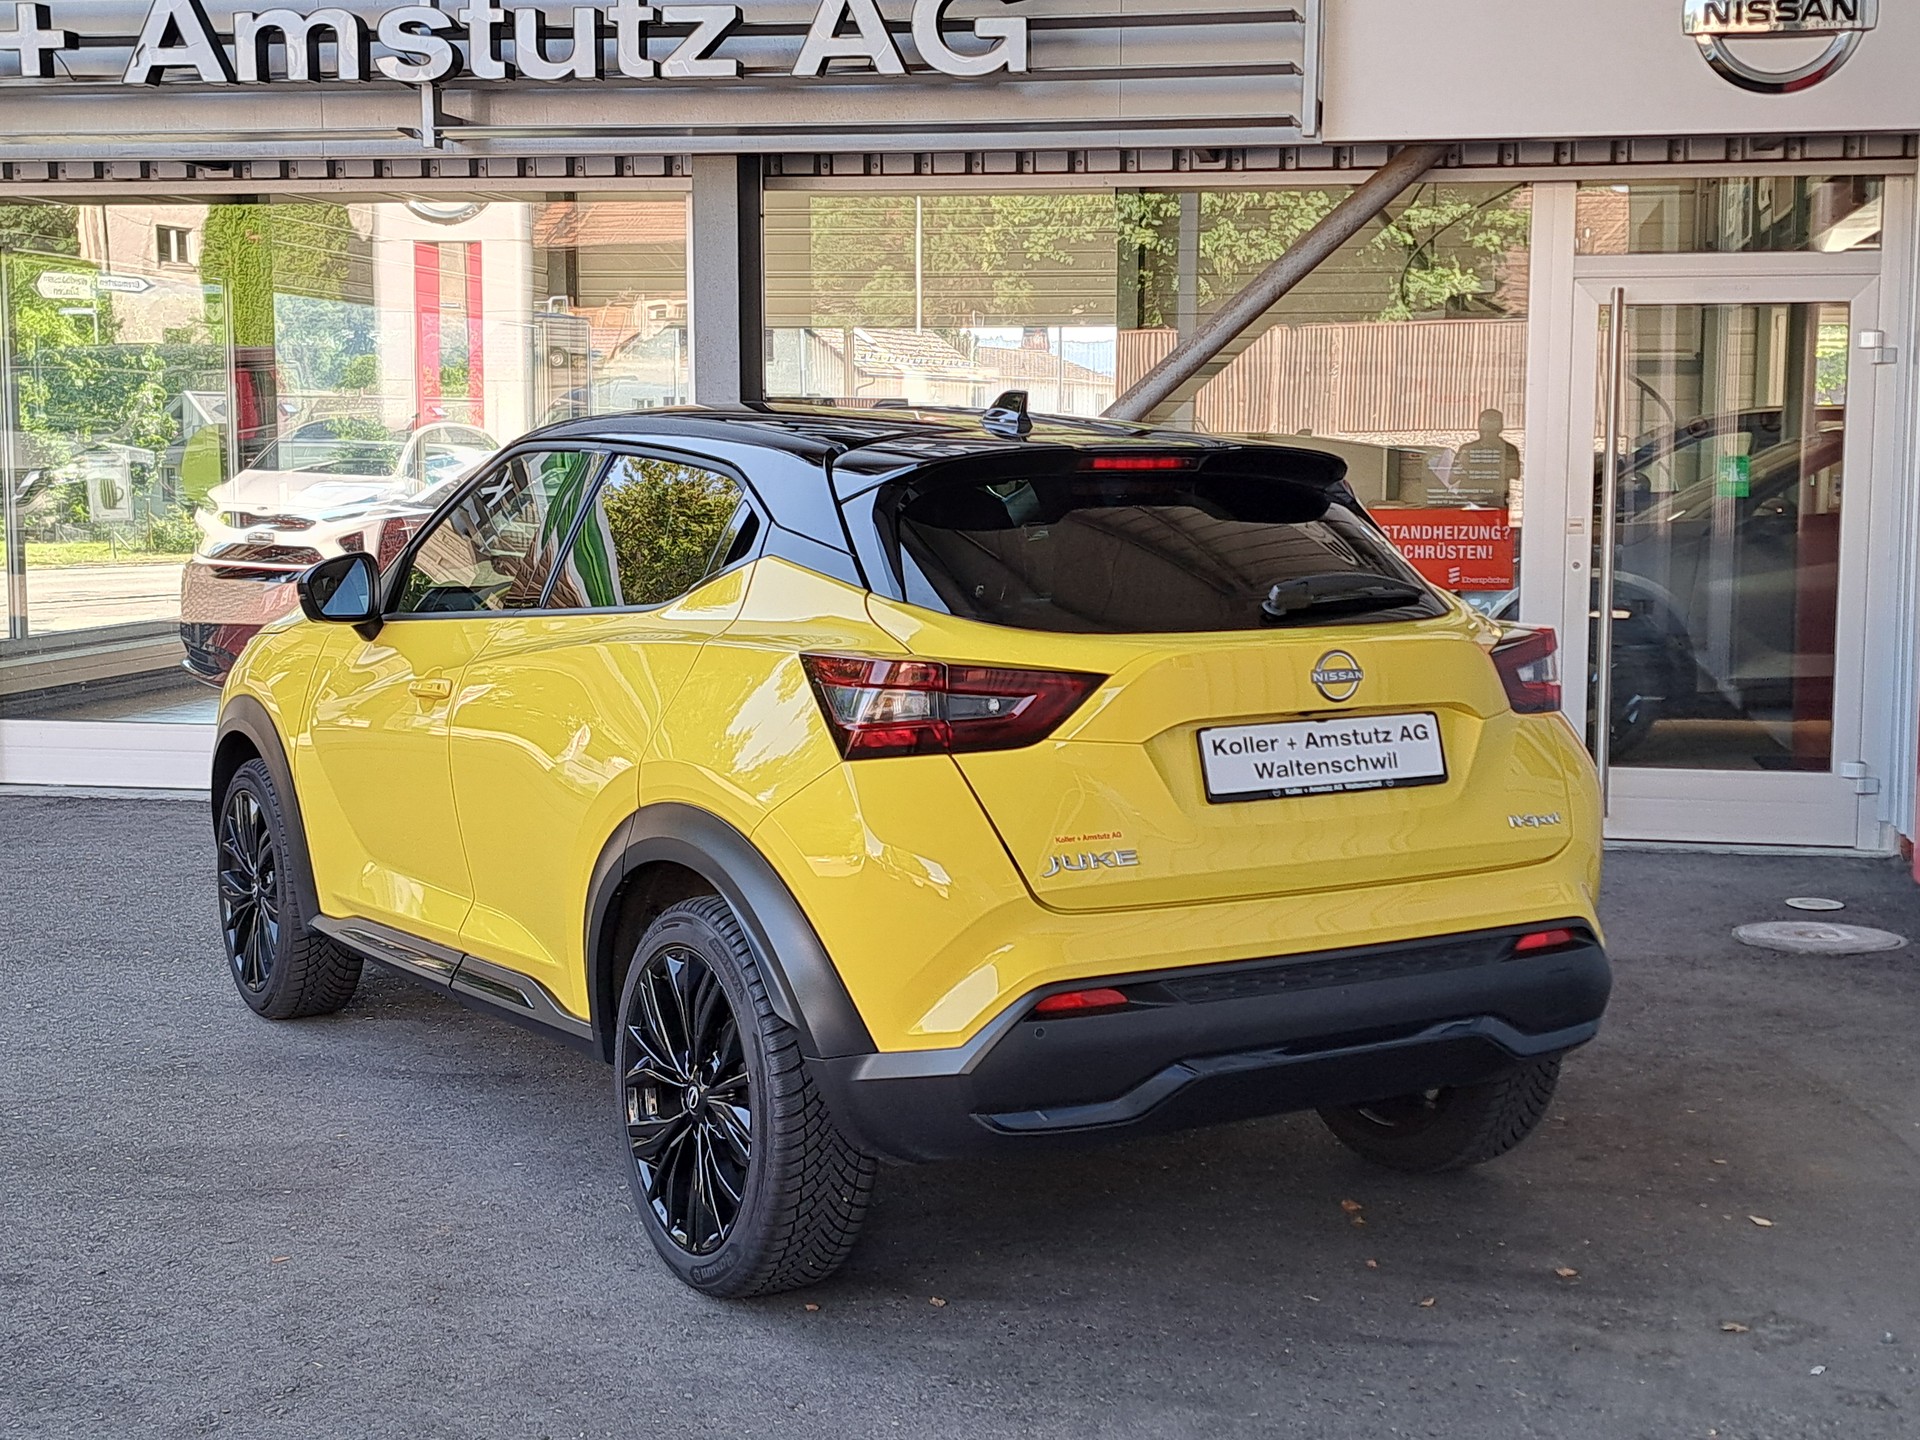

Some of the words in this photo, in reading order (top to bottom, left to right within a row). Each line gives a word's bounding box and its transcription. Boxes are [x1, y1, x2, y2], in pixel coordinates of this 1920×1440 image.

[1703, 0, 1858, 26] NISSAN
[122, 0, 743, 83] Amstutz
[790, 0, 1028, 78] AG
[1381, 524, 1511, 541] STANDHEIZUNG?
[1312, 667, 1363, 682] NISSAN
[1212, 735, 1279, 757] Koller
[1287, 739, 1298, 751] +
[1305, 726, 1393, 749] Amstutz
[1399, 723, 1430, 742] AG
[1253, 751, 1399, 779] Waltenschwil
[1055, 835, 1076, 844] Koller
[1082, 833, 1110, 842] Amstutz
[1111, 831, 1122, 839] AG
[1042, 849, 1141, 878] JUKE
